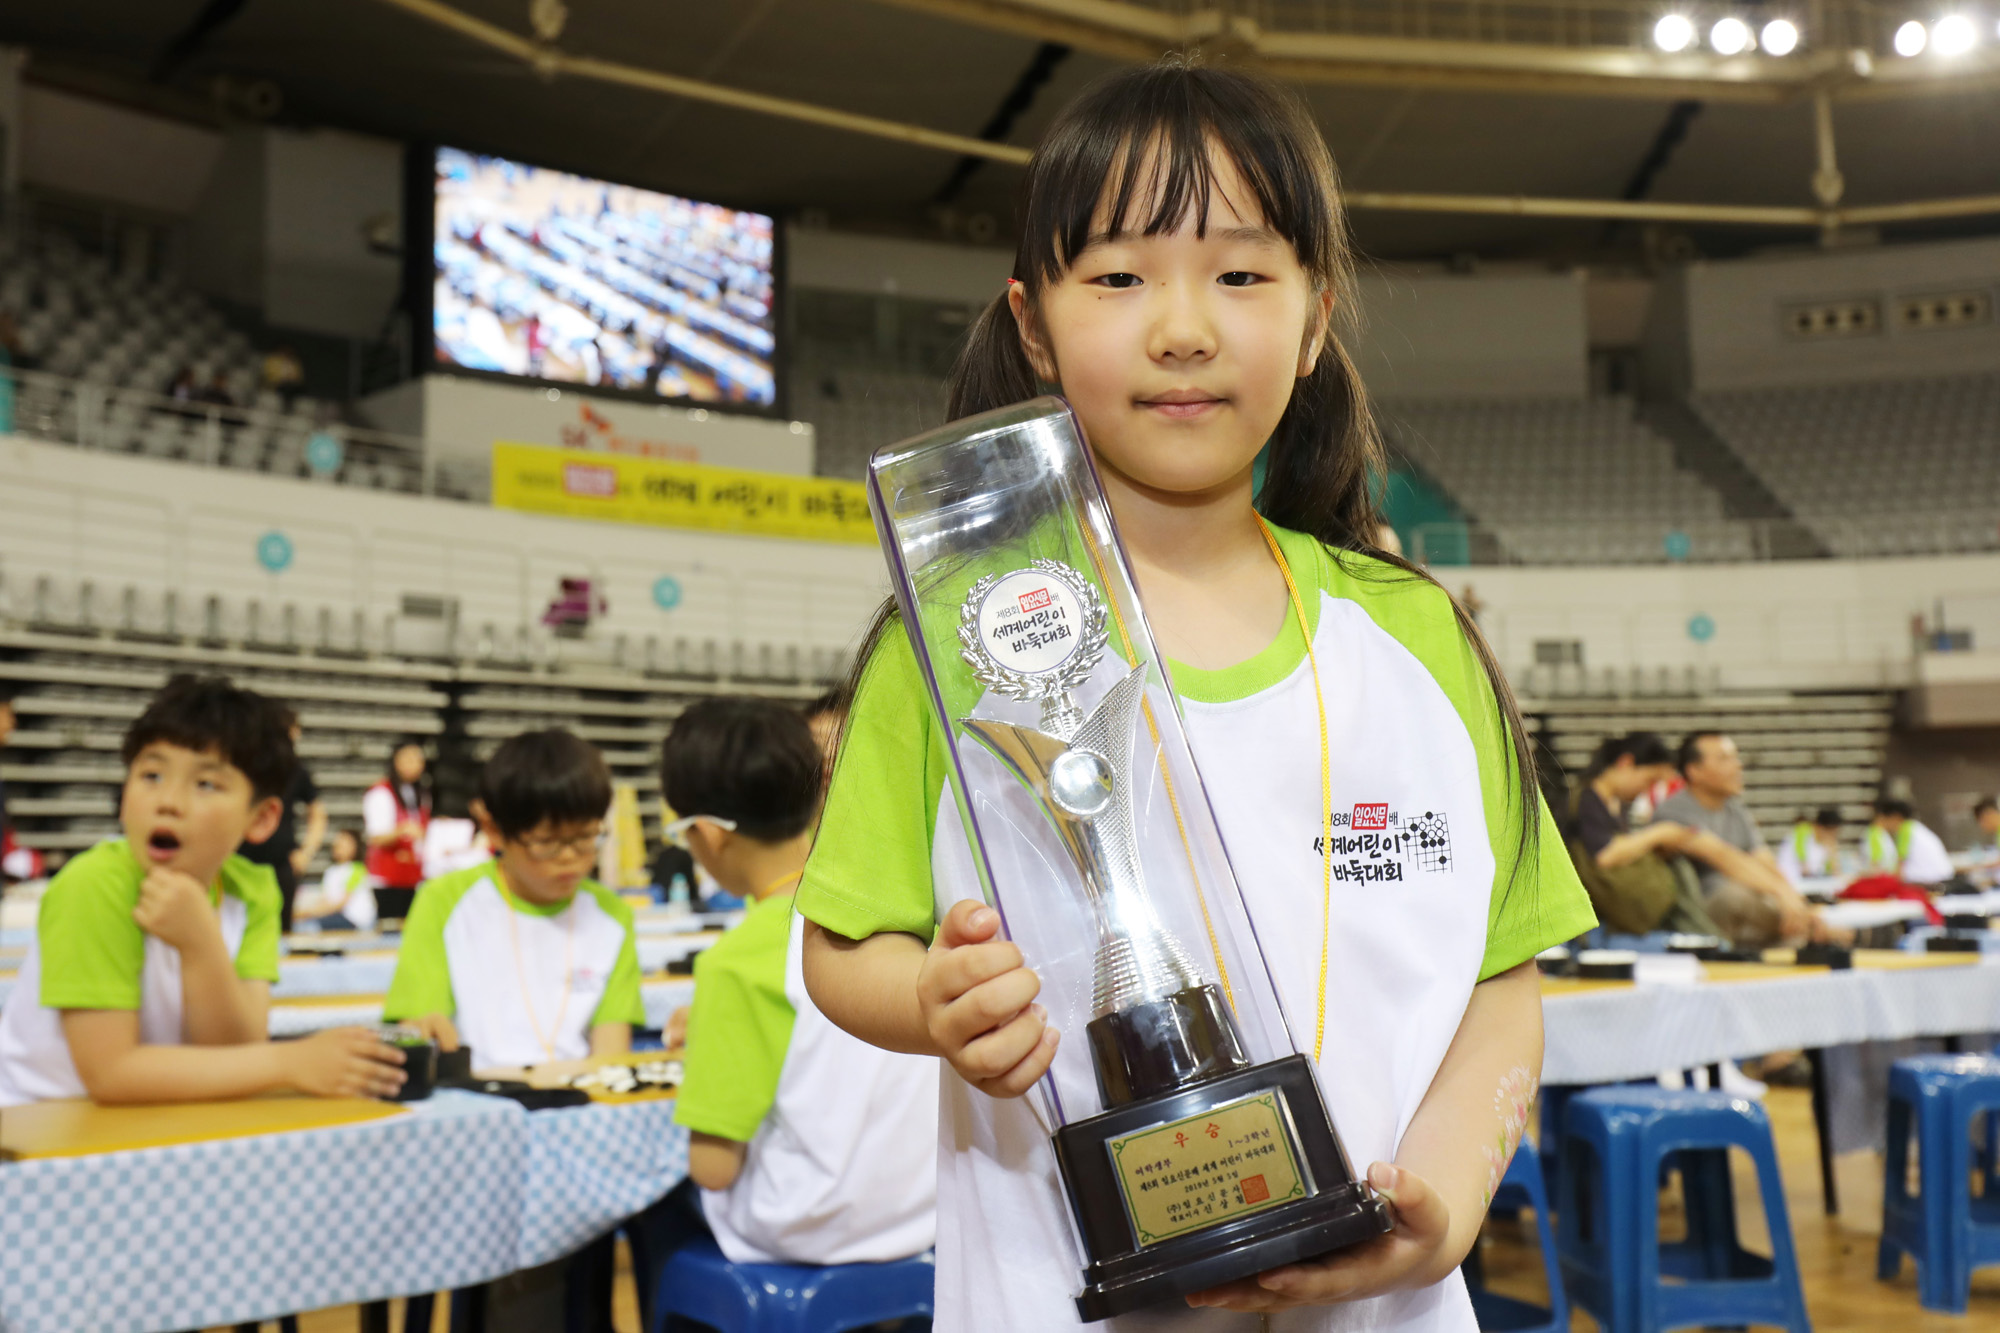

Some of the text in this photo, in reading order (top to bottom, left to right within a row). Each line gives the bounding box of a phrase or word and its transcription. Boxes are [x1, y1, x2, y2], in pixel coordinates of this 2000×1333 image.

[996, 590, 1060, 619] 제8회 일요신문 배
[993, 607, 1065, 640] 세계어린이
[1012, 624, 1071, 653] 바둑대회
[1322, 806, 1398, 827] 8회 일요신문 배
[1333, 859, 1403, 887] 바둑대회
[1135, 1158, 1172, 1176] 여학생부
[1161, 1166, 1199, 1186] 일요신문배
[1220, 1153, 1243, 1167] 어린이
[1245, 1143, 1276, 1159] 바둑대회
